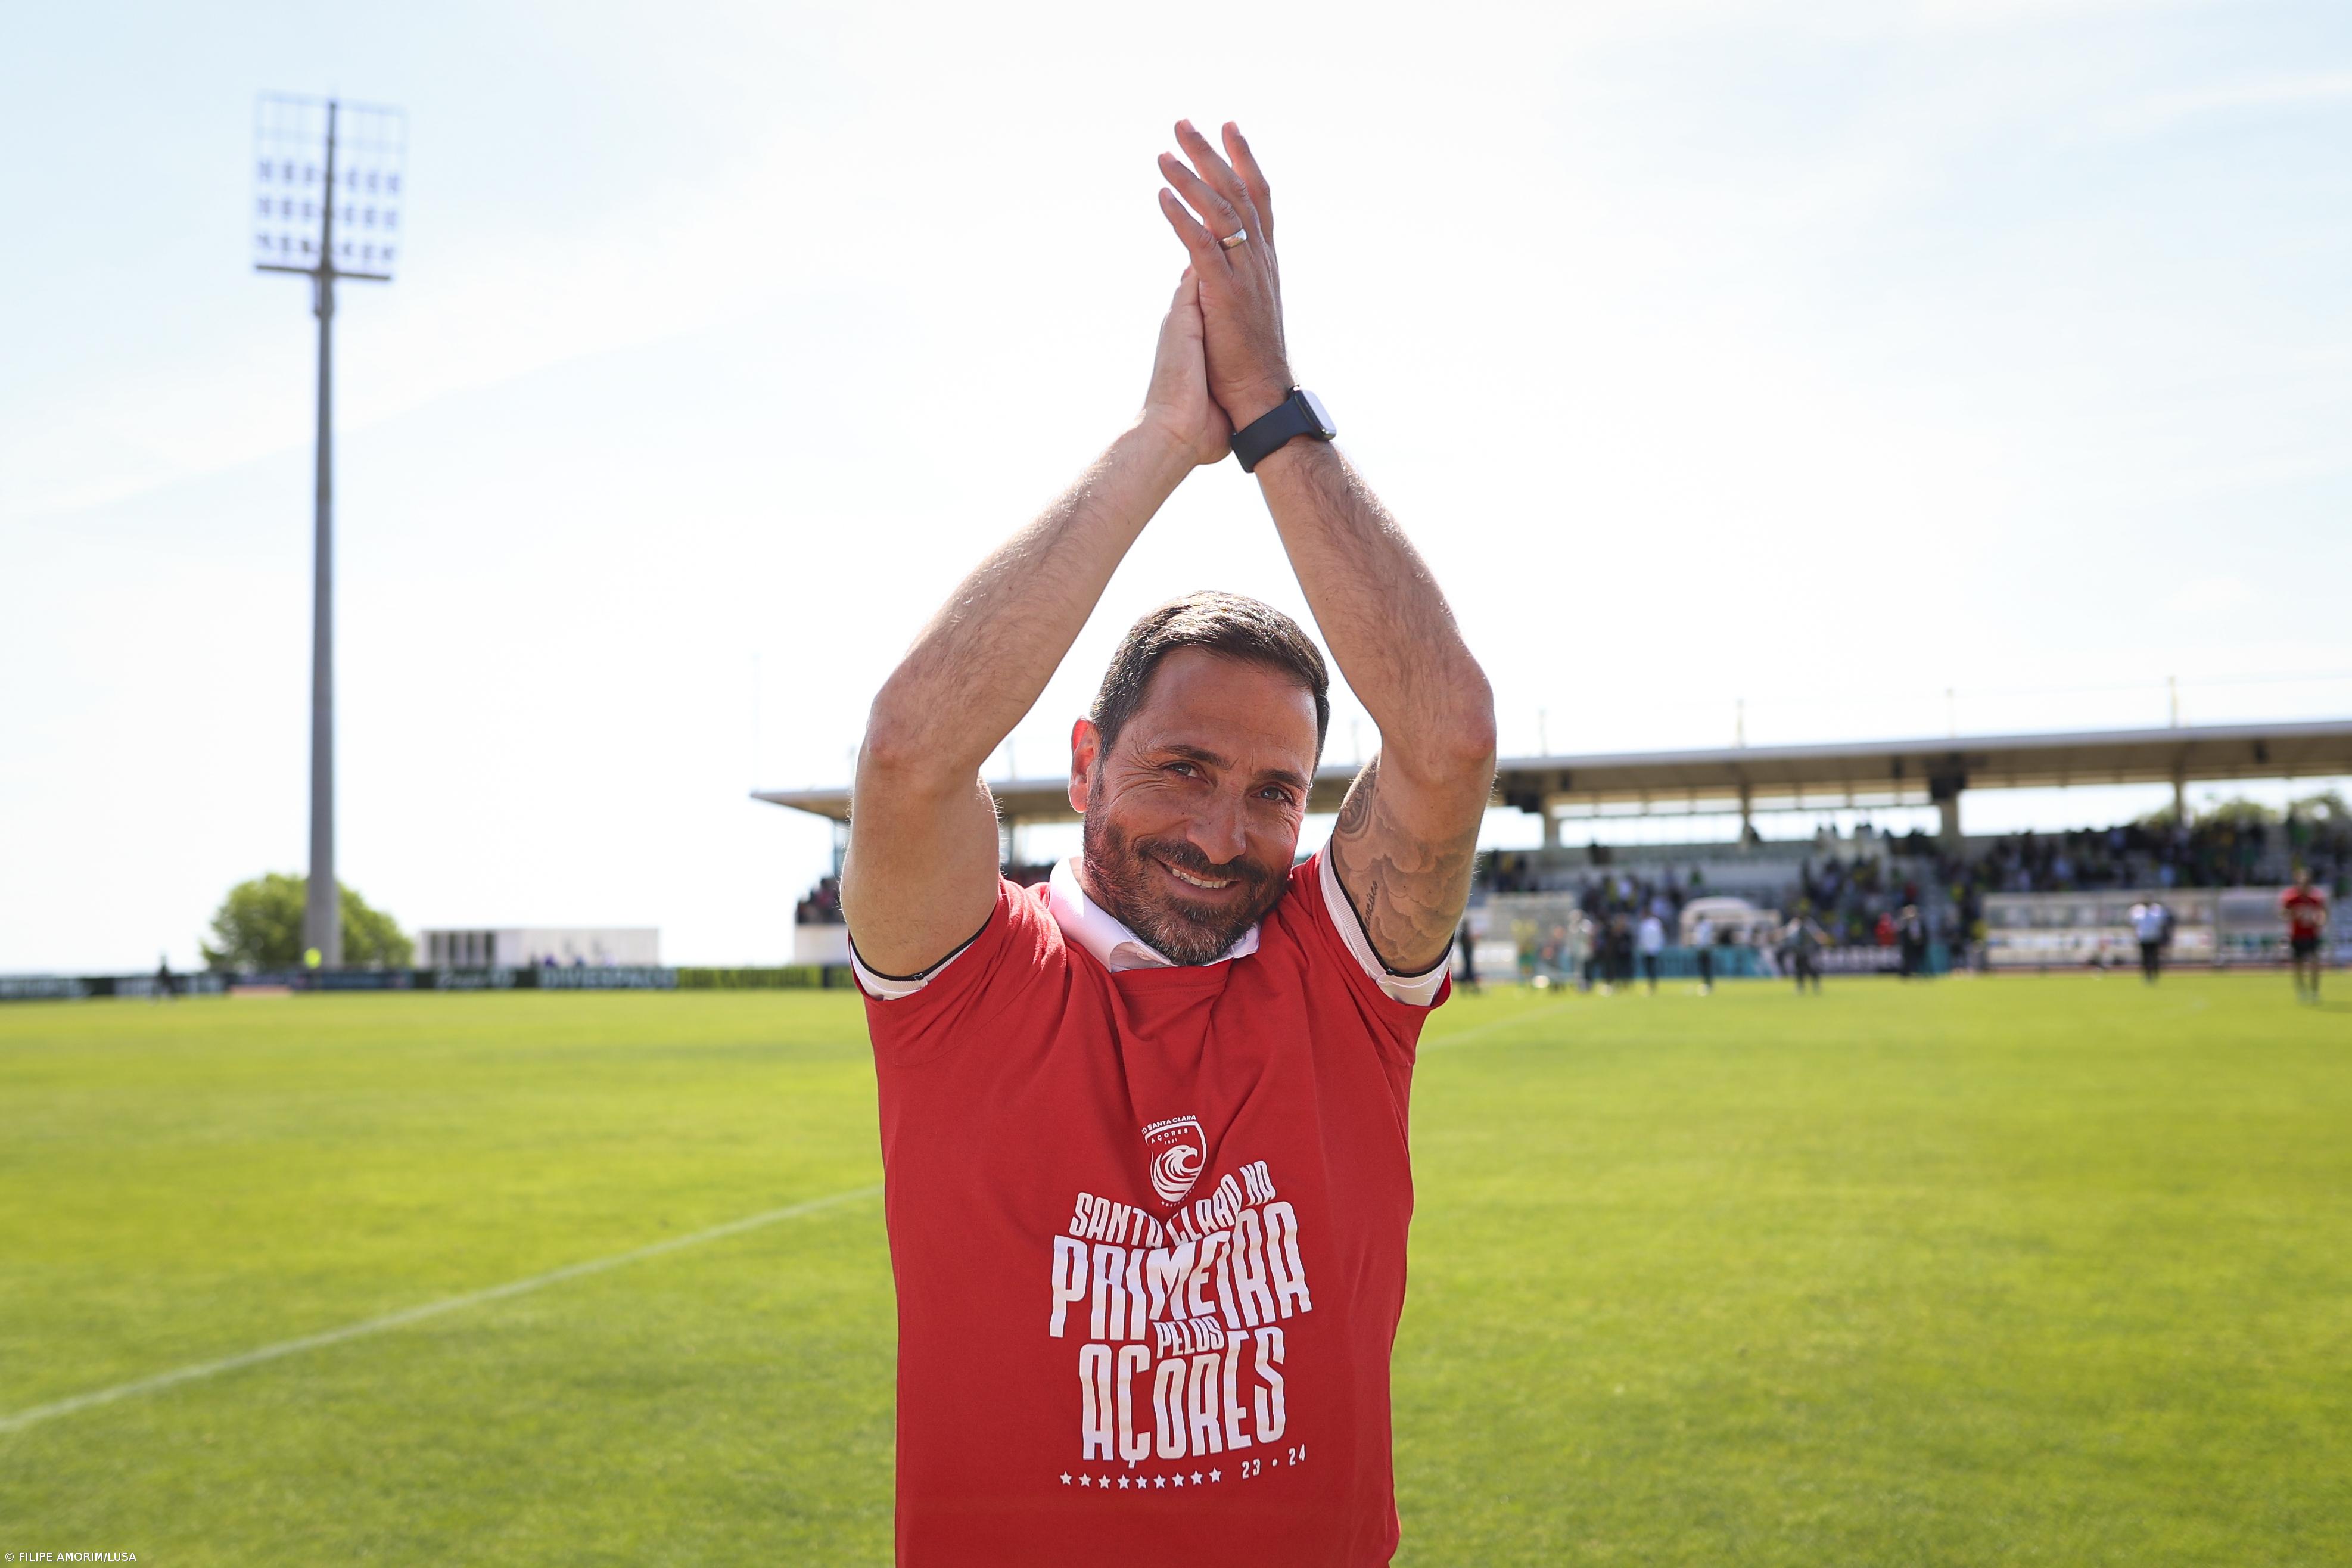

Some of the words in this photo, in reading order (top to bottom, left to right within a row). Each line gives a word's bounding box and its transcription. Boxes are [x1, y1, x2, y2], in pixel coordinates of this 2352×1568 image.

[1147, 1119, 1172, 1130] SANTA
[1172, 1115, 1196, 1123] CLARA
[1151, 1128, 1188, 1144] AÇORES
[1069, 1192, 1164, 1249] SANTA
[1049, 1201, 1312, 1340] PRIMEIRA
[1153, 1316, 1224, 1358] PELOS
[1079, 1326, 1286, 1468] AÇORES
[1242, 1458, 1261, 1479] 23
[1289, 1443, 1305, 1466] 24
